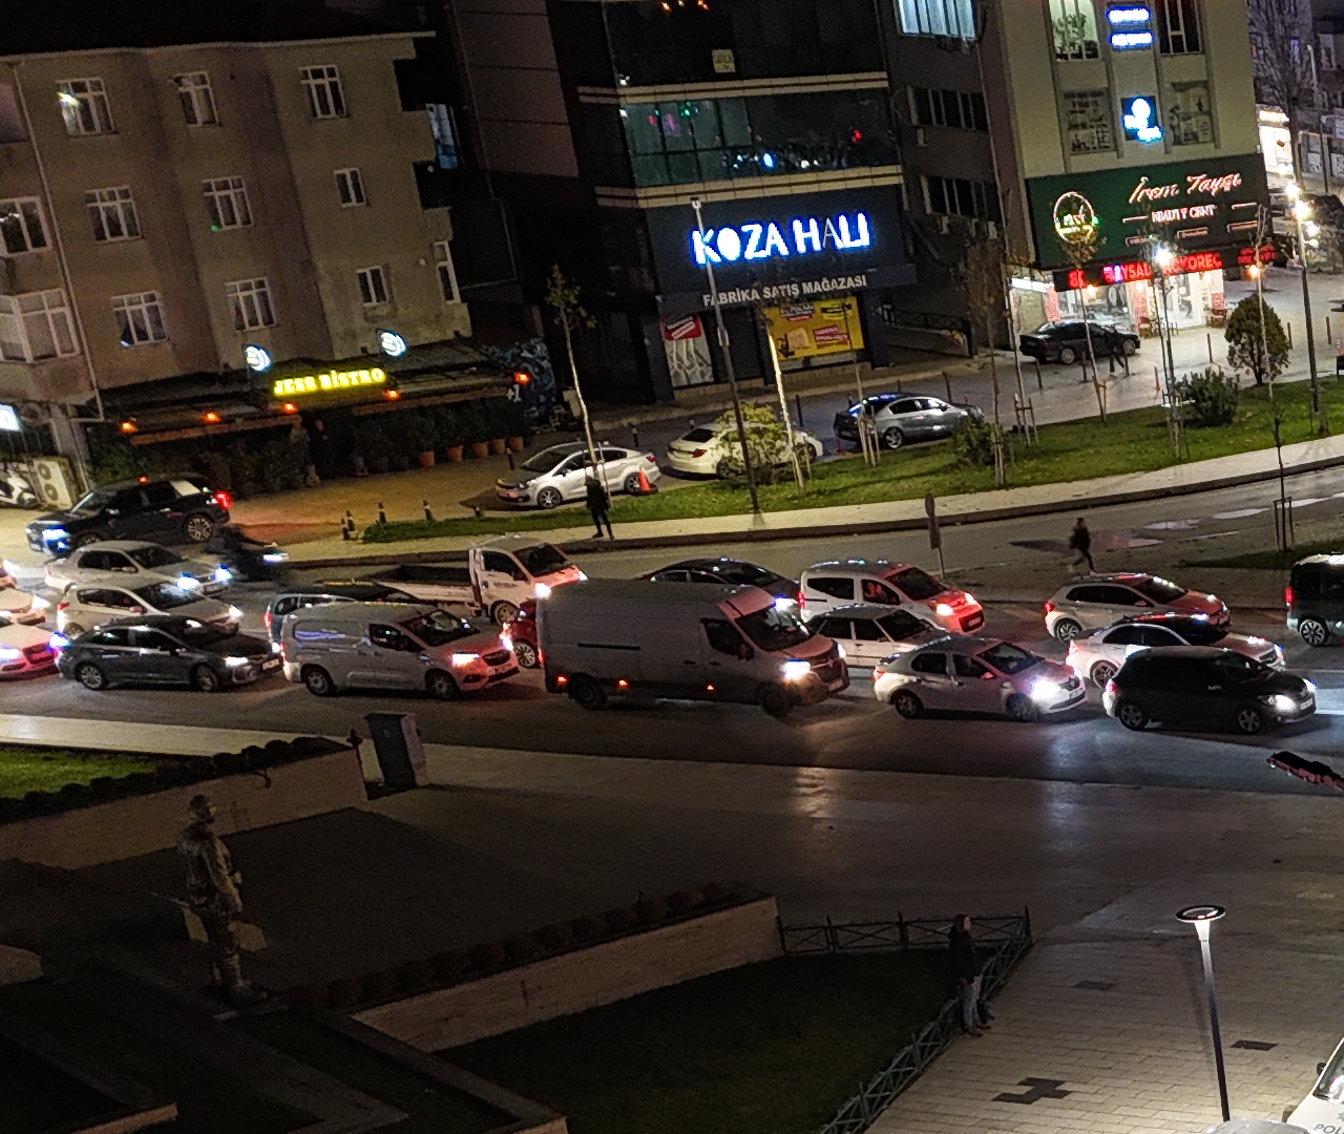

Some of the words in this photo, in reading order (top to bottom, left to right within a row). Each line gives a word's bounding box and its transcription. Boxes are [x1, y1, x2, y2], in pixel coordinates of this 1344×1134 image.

[691, 222, 790, 264] KOZA
[792, 212, 871, 254] HALI
[702, 289, 760, 307] FABRİKA
[763, 283, 799, 299] SATIŞ
[802, 275, 867, 295] MAĞAZASI
